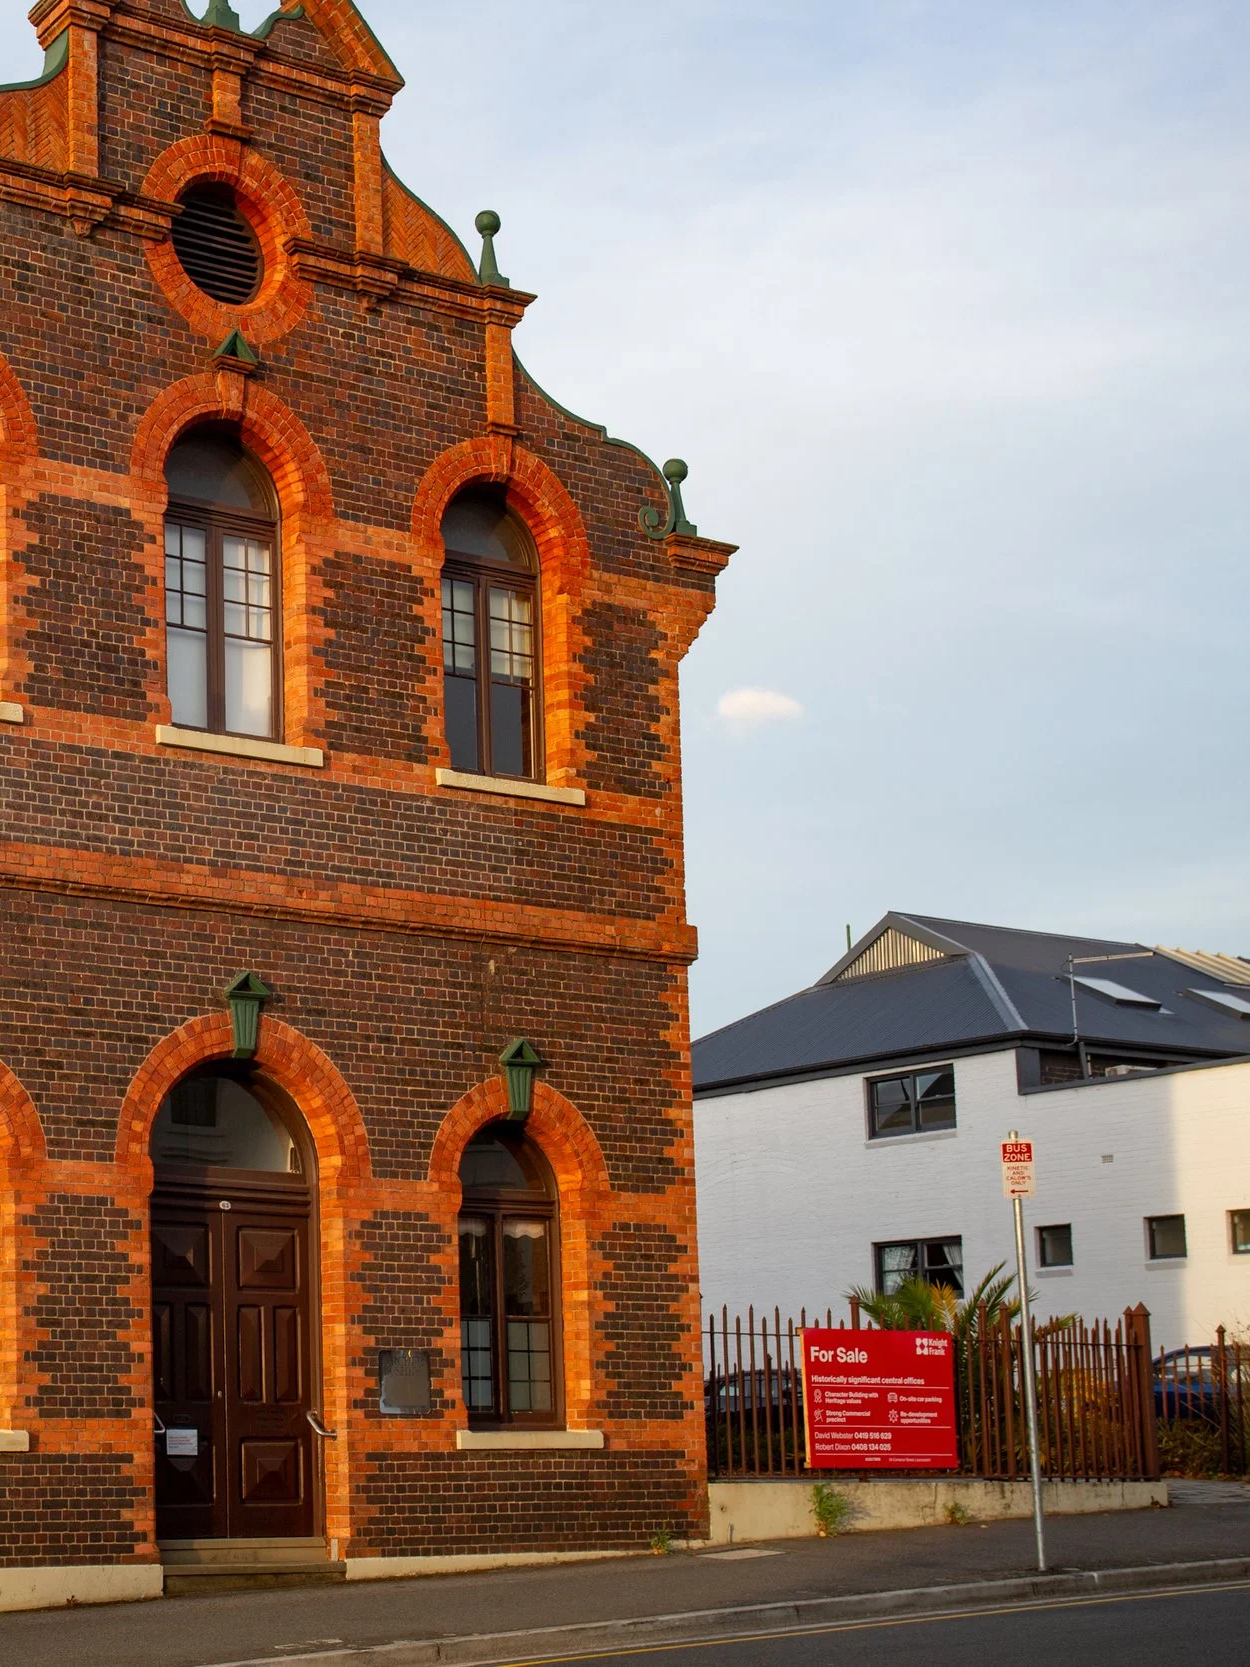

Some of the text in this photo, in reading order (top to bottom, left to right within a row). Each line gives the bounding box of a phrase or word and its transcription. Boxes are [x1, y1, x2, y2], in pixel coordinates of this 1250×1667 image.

[1006, 1144, 1027, 1152] BUS
[1003, 1153, 1031, 1161] ZONE
[928, 1338, 948, 1349] Knight
[810, 1346, 868, 1363] For Sale
[928, 1347, 946, 1356] Frank
[811, 1375, 925, 1385] Historically significant central offices
[849, 1391, 869, 1399] Building
[868, 1443, 879, 1451] 134
[879, 1443, 892, 1451] 025
